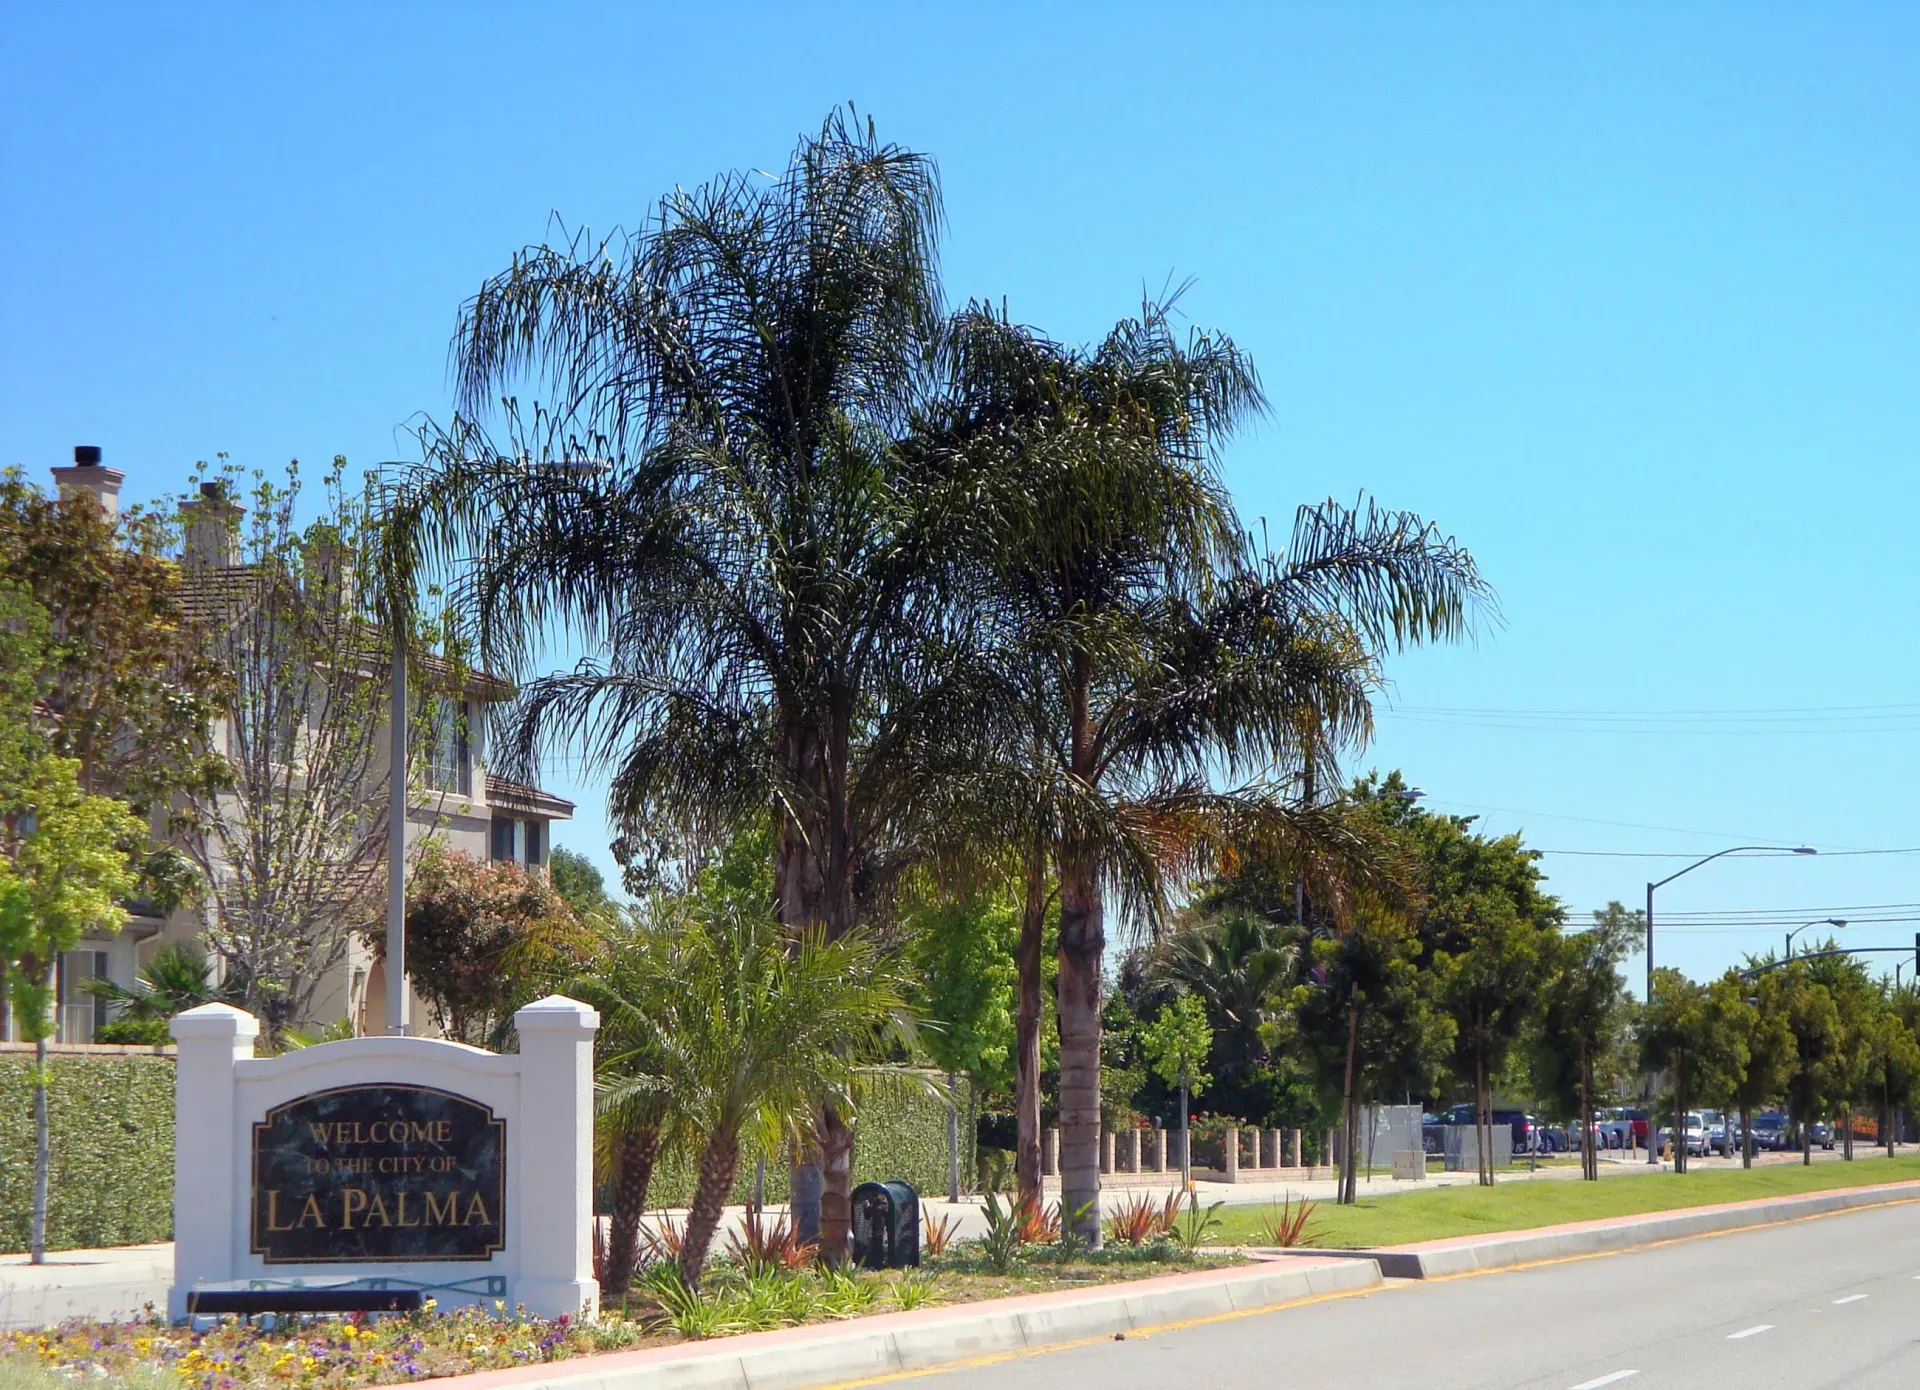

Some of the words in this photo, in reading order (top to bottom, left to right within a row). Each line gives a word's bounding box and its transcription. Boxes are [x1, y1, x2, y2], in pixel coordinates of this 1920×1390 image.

[309, 1120, 453, 1144] WELCOME
[306, 1158, 330, 1175] TO
[335, 1157, 374, 1174] THE
[379, 1155, 425, 1173] CITY
[430, 1156, 457, 1173] OF
[266, 1190, 328, 1231] LA
[340, 1188, 493, 1230] PALMA
